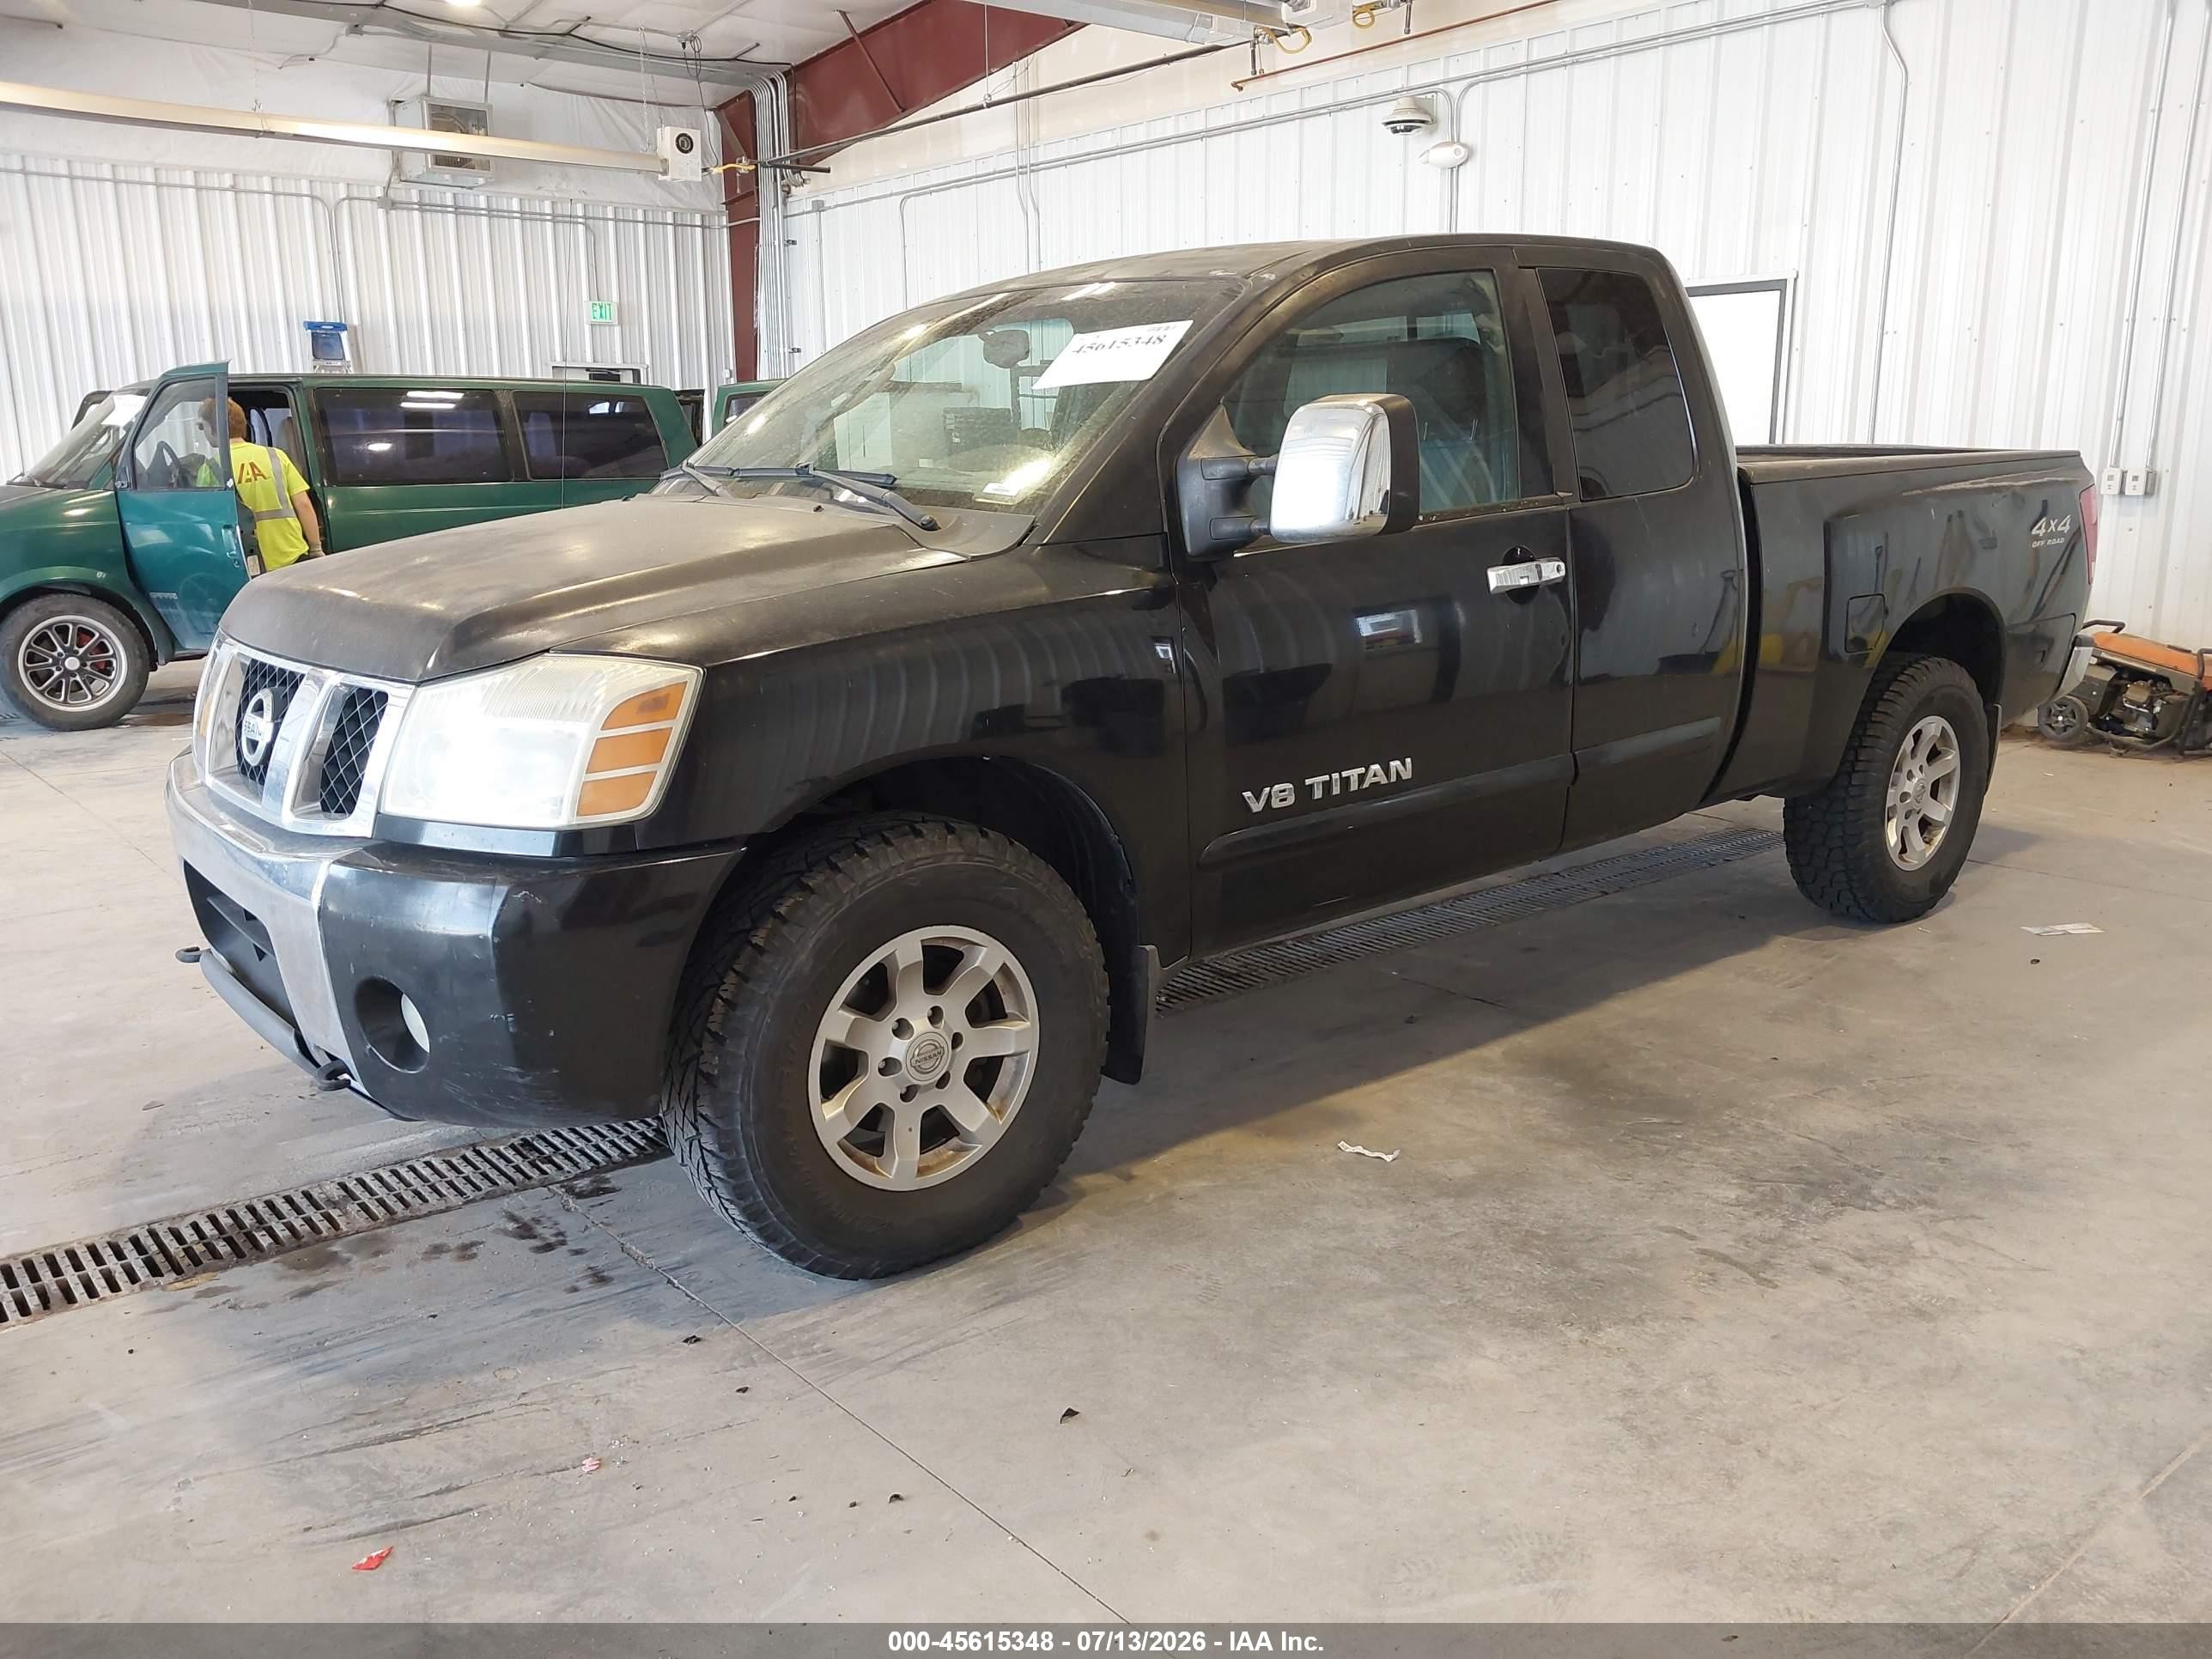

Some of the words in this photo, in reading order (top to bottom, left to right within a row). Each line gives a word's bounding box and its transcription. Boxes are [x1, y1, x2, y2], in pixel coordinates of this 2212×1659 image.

[592, 302, 611, 320] EXIT
[1242, 782, 1296, 813] V8
[1304, 757, 1413, 800] TITAN
[915, 1050, 942, 1065] NISSAN
